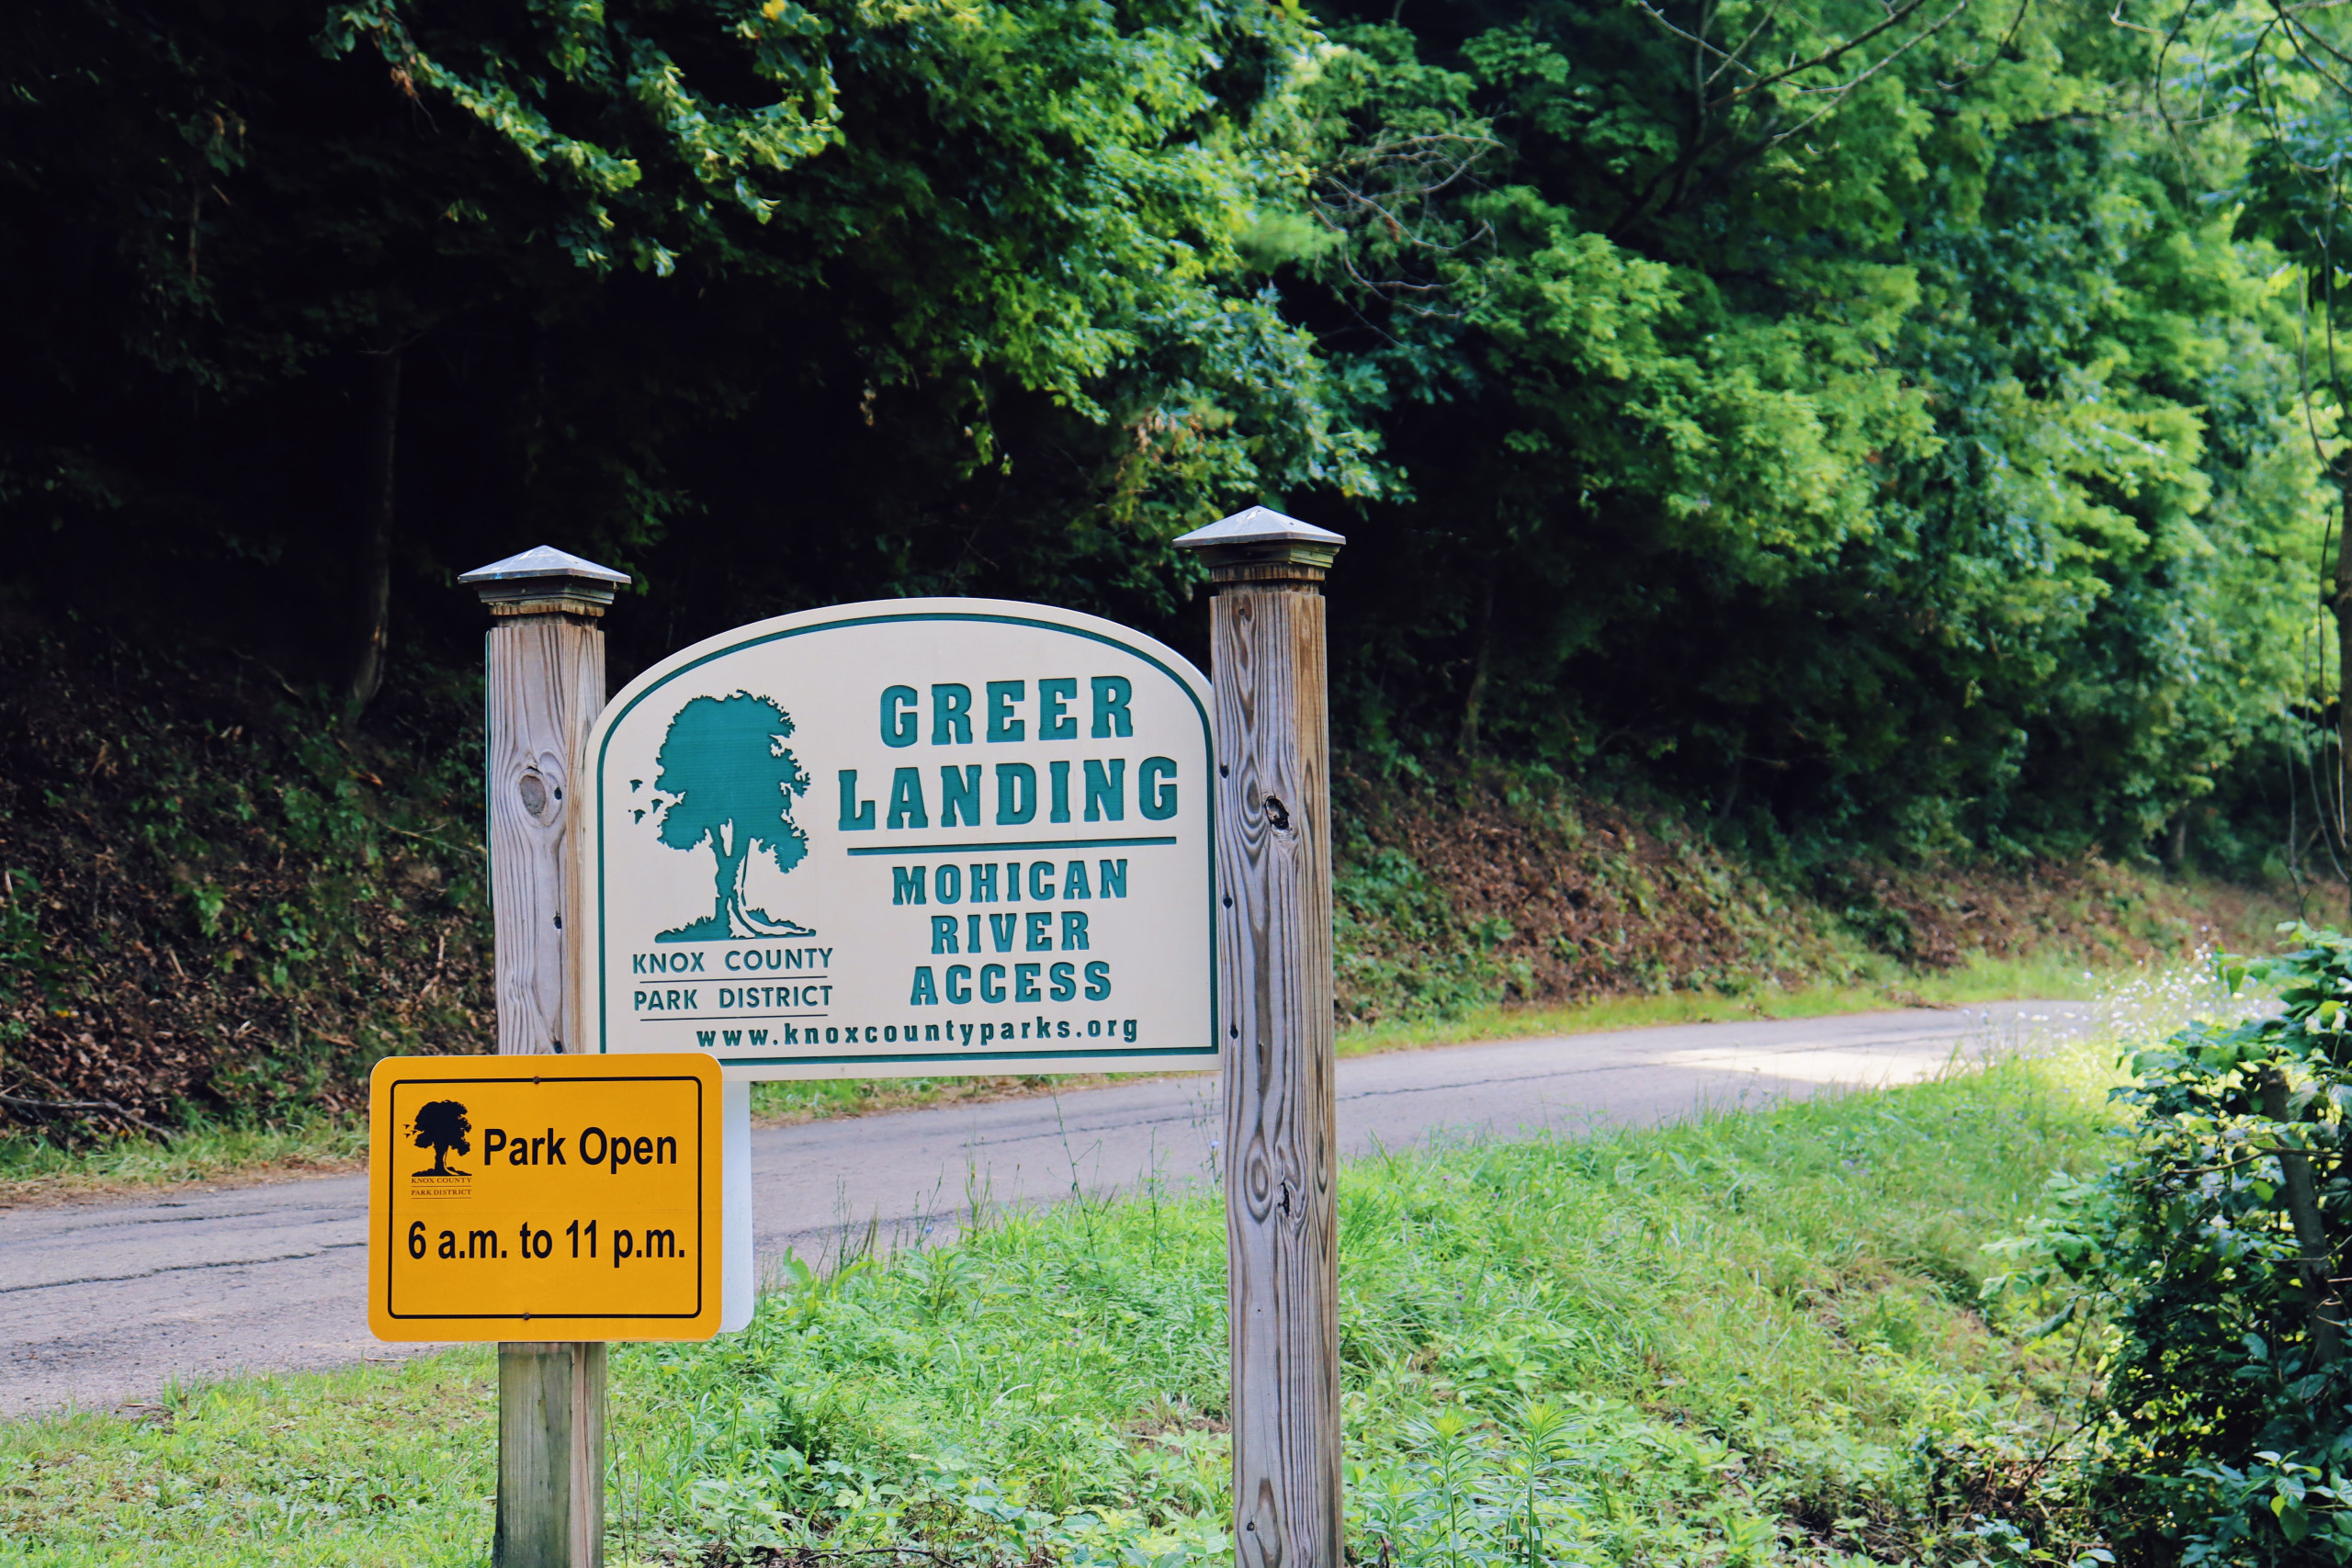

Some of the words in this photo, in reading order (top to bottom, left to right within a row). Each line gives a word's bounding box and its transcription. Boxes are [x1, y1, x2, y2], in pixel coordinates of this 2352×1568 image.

[880, 676, 1133, 748] GREER
[839, 757, 1177, 830] LANDING
[892, 859, 1127, 906] MOHICAN
[931, 911, 1090, 955] RIVER
[632, 953, 705, 975] KNOX
[724, 948, 833, 971] COUNTY
[910, 961, 1112, 1006] ACCESS
[634, 989, 698, 1011] PARK
[718, 986, 833, 1009] DISTRICT
[696, 1017, 1138, 1047] www.knoxcountyparks.org
[484, 1127, 567, 1167] Park
[579, 1126, 677, 1175] Open
[408, 1220, 426, 1260] 6
[438, 1229, 507, 1259] a.m.
[519, 1222, 553, 1259] to
[566, 1219, 597, 1258] 11
[614, 1228, 685, 1269] p.m.
